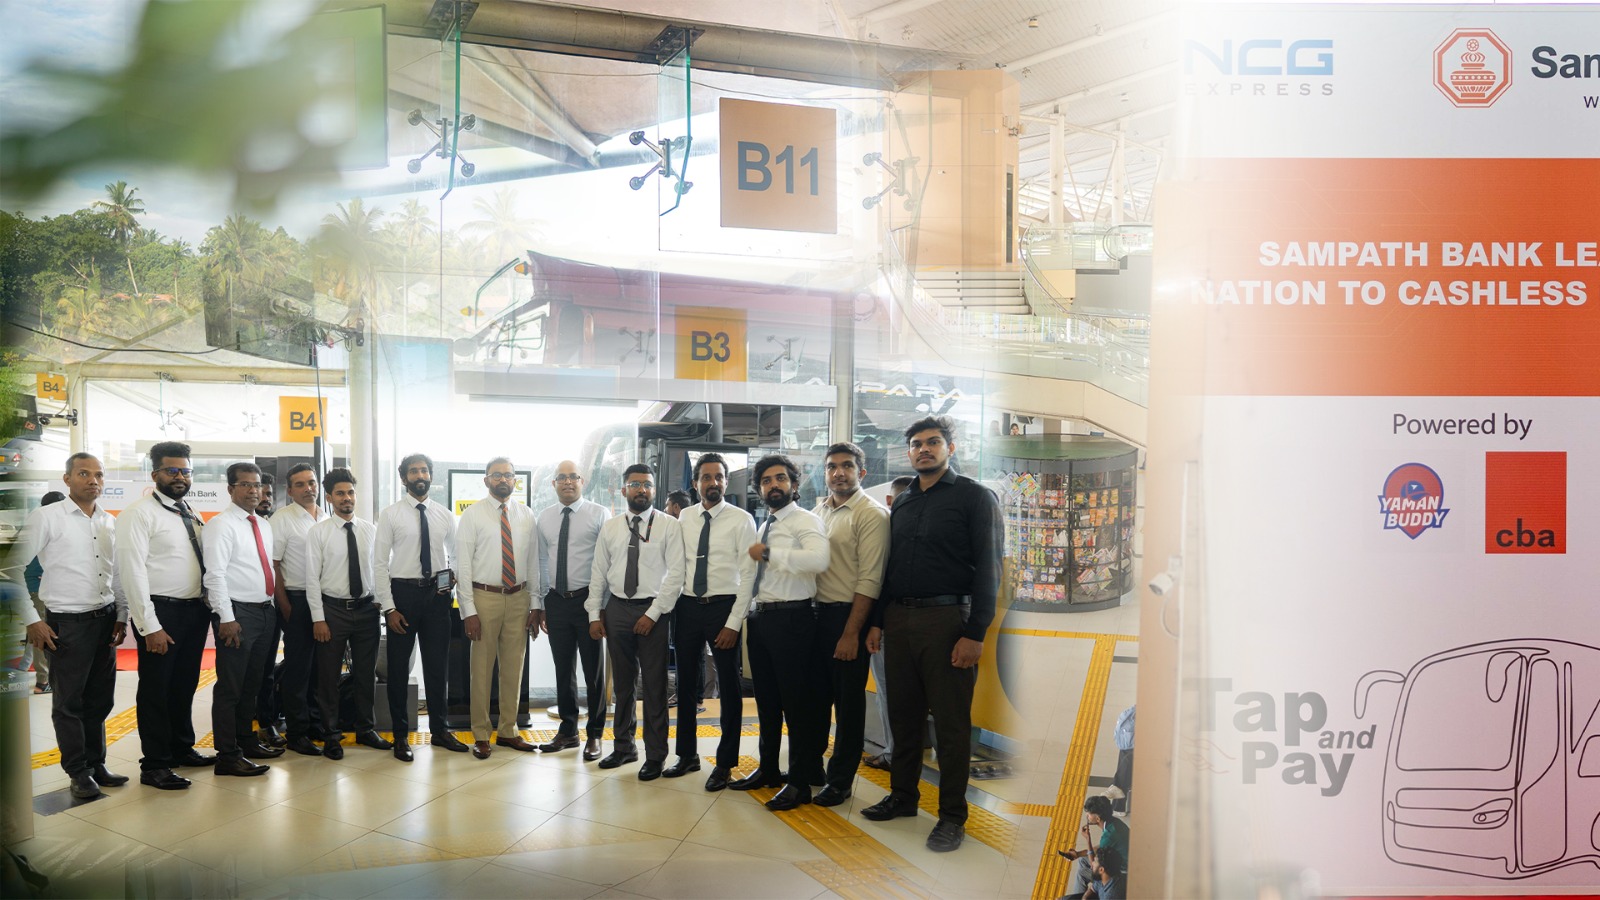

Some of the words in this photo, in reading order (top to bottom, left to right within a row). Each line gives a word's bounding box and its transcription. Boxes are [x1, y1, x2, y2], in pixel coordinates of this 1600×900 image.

[1184, 39, 1333, 76] NCG
[1185, 83, 1334, 97] EXPRESS
[737, 140, 819, 196] B11
[1258, 241, 1428, 267] SAMPATH
[1441, 241, 1544, 267] BANK
[1555, 242, 1600, 267] LE
[1190, 280, 1326, 306] NATION
[1338, 280, 1386, 306] TO
[1398, 280, 1588, 306] CASHLESS
[691, 330, 731, 363] B3
[43, 381, 60, 393] B4
[290, 411, 317, 431] B4
[1393, 412, 1496, 435] Powered
[1504, 412, 1533, 440] by
[102, 487, 124, 496] CG
[197, 490, 217, 498] Bank
[1381, 495, 1440, 511] YAMAN
[1386, 511, 1445, 528] BUDDY
[1496, 518, 1555, 548] cba
[1182, 677, 1328, 747] Tap
[1318, 724, 1377, 749] and
[1242, 741, 1355, 797] Pay
